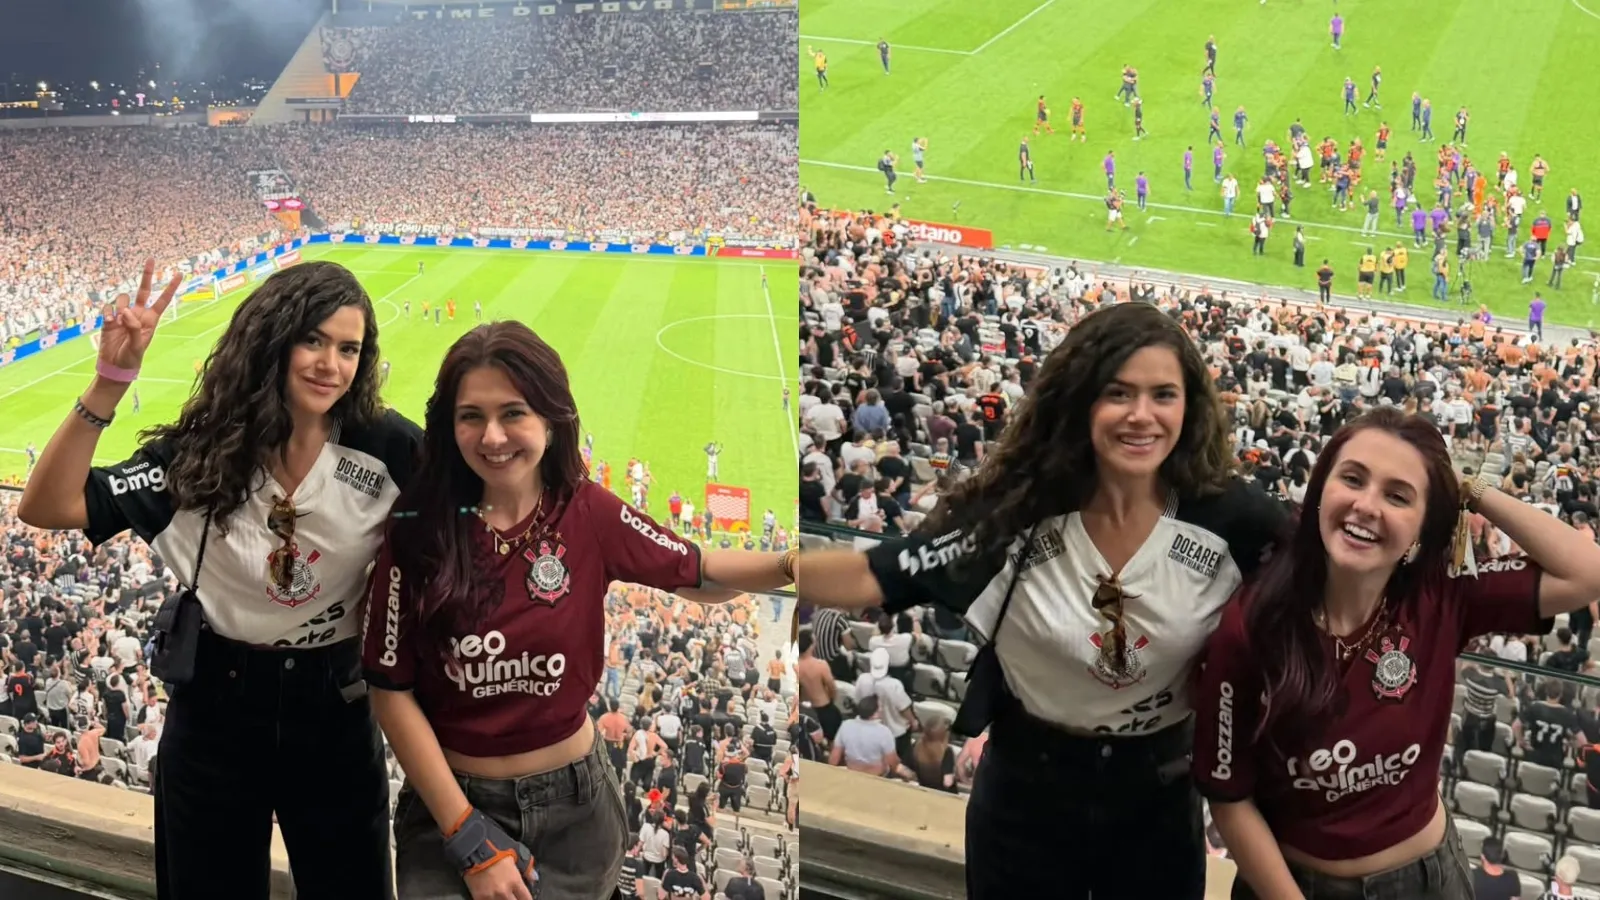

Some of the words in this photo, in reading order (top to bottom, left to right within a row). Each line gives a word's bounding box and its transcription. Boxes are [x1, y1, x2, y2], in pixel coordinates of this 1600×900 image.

[412, 8, 495, 20] TIME
[513, 5, 556, 16] DO
[575, 0, 673, 13] POVO
[908, 223, 962, 243] etano
[108, 465, 168, 496] bmg
[122, 462, 149, 474] banco
[336, 456, 386, 491] DOEAREN
[620, 504, 688, 556] bozzano
[379, 566, 402, 667] bozzano
[1211, 682, 1234, 780] bozzano
[1535, 719, 1563, 743] 77
